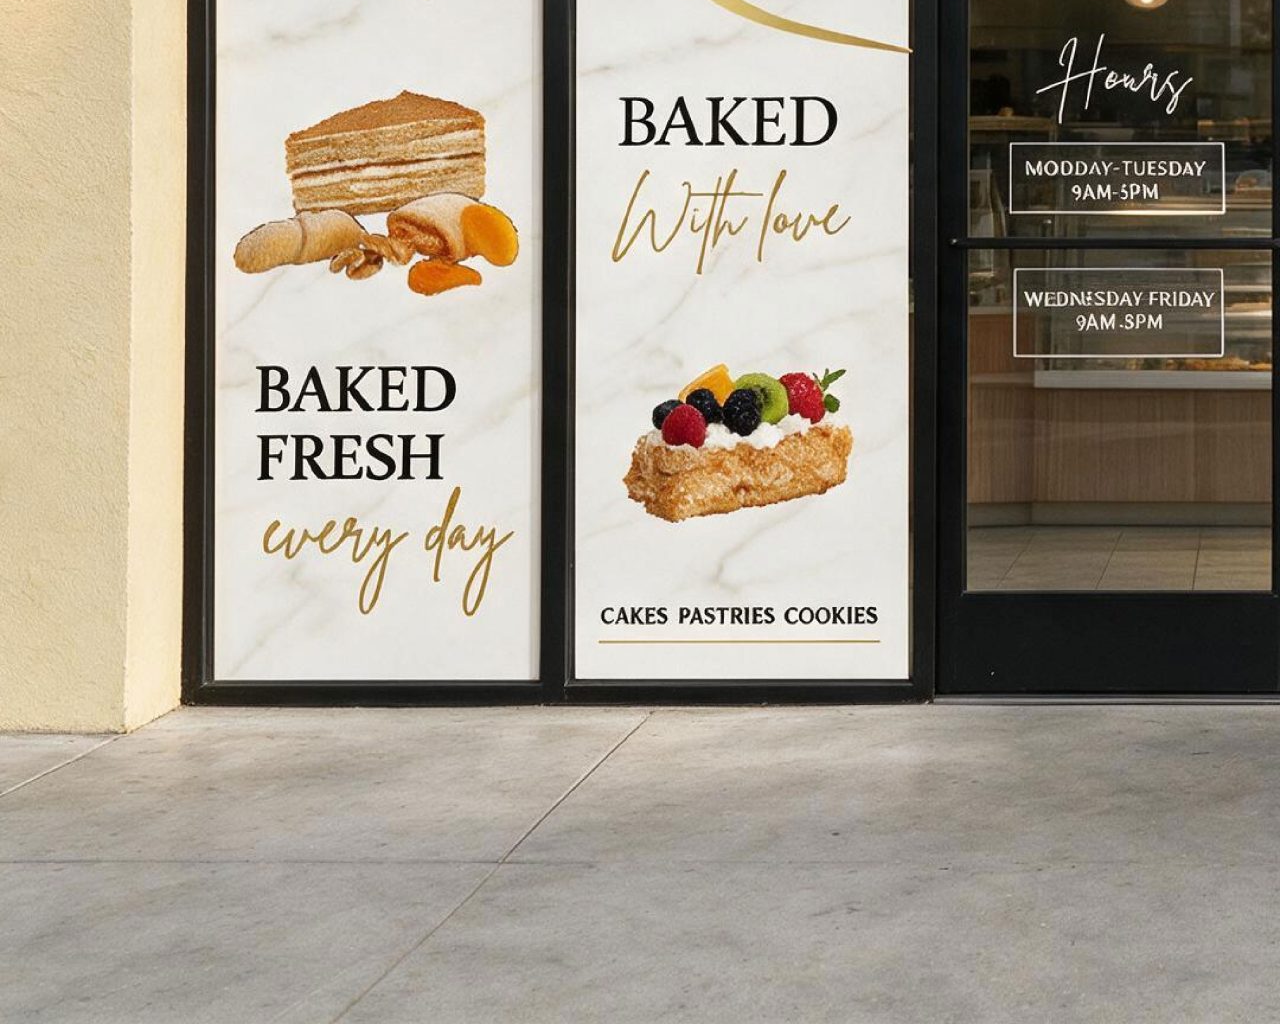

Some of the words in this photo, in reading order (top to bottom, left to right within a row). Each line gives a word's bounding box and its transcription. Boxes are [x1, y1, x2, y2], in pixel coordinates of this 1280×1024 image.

[1036, 33, 1193, 124] Hours
[618, 96, 838, 146] BAKED
[612, 169, 764, 275] With
[757, 169, 852, 263] love
[1149, 291, 1215, 308] FRIDAY
[255, 365, 456, 412] BAKED
[256, 433, 445, 480] FRESH
[263, 517, 409, 615] every
[424, 486, 514, 616] day
[600, 606, 668, 625] CAKES
[678, 606, 776, 625] PASTRIES
[783, 606, 879, 625] COOKIES
